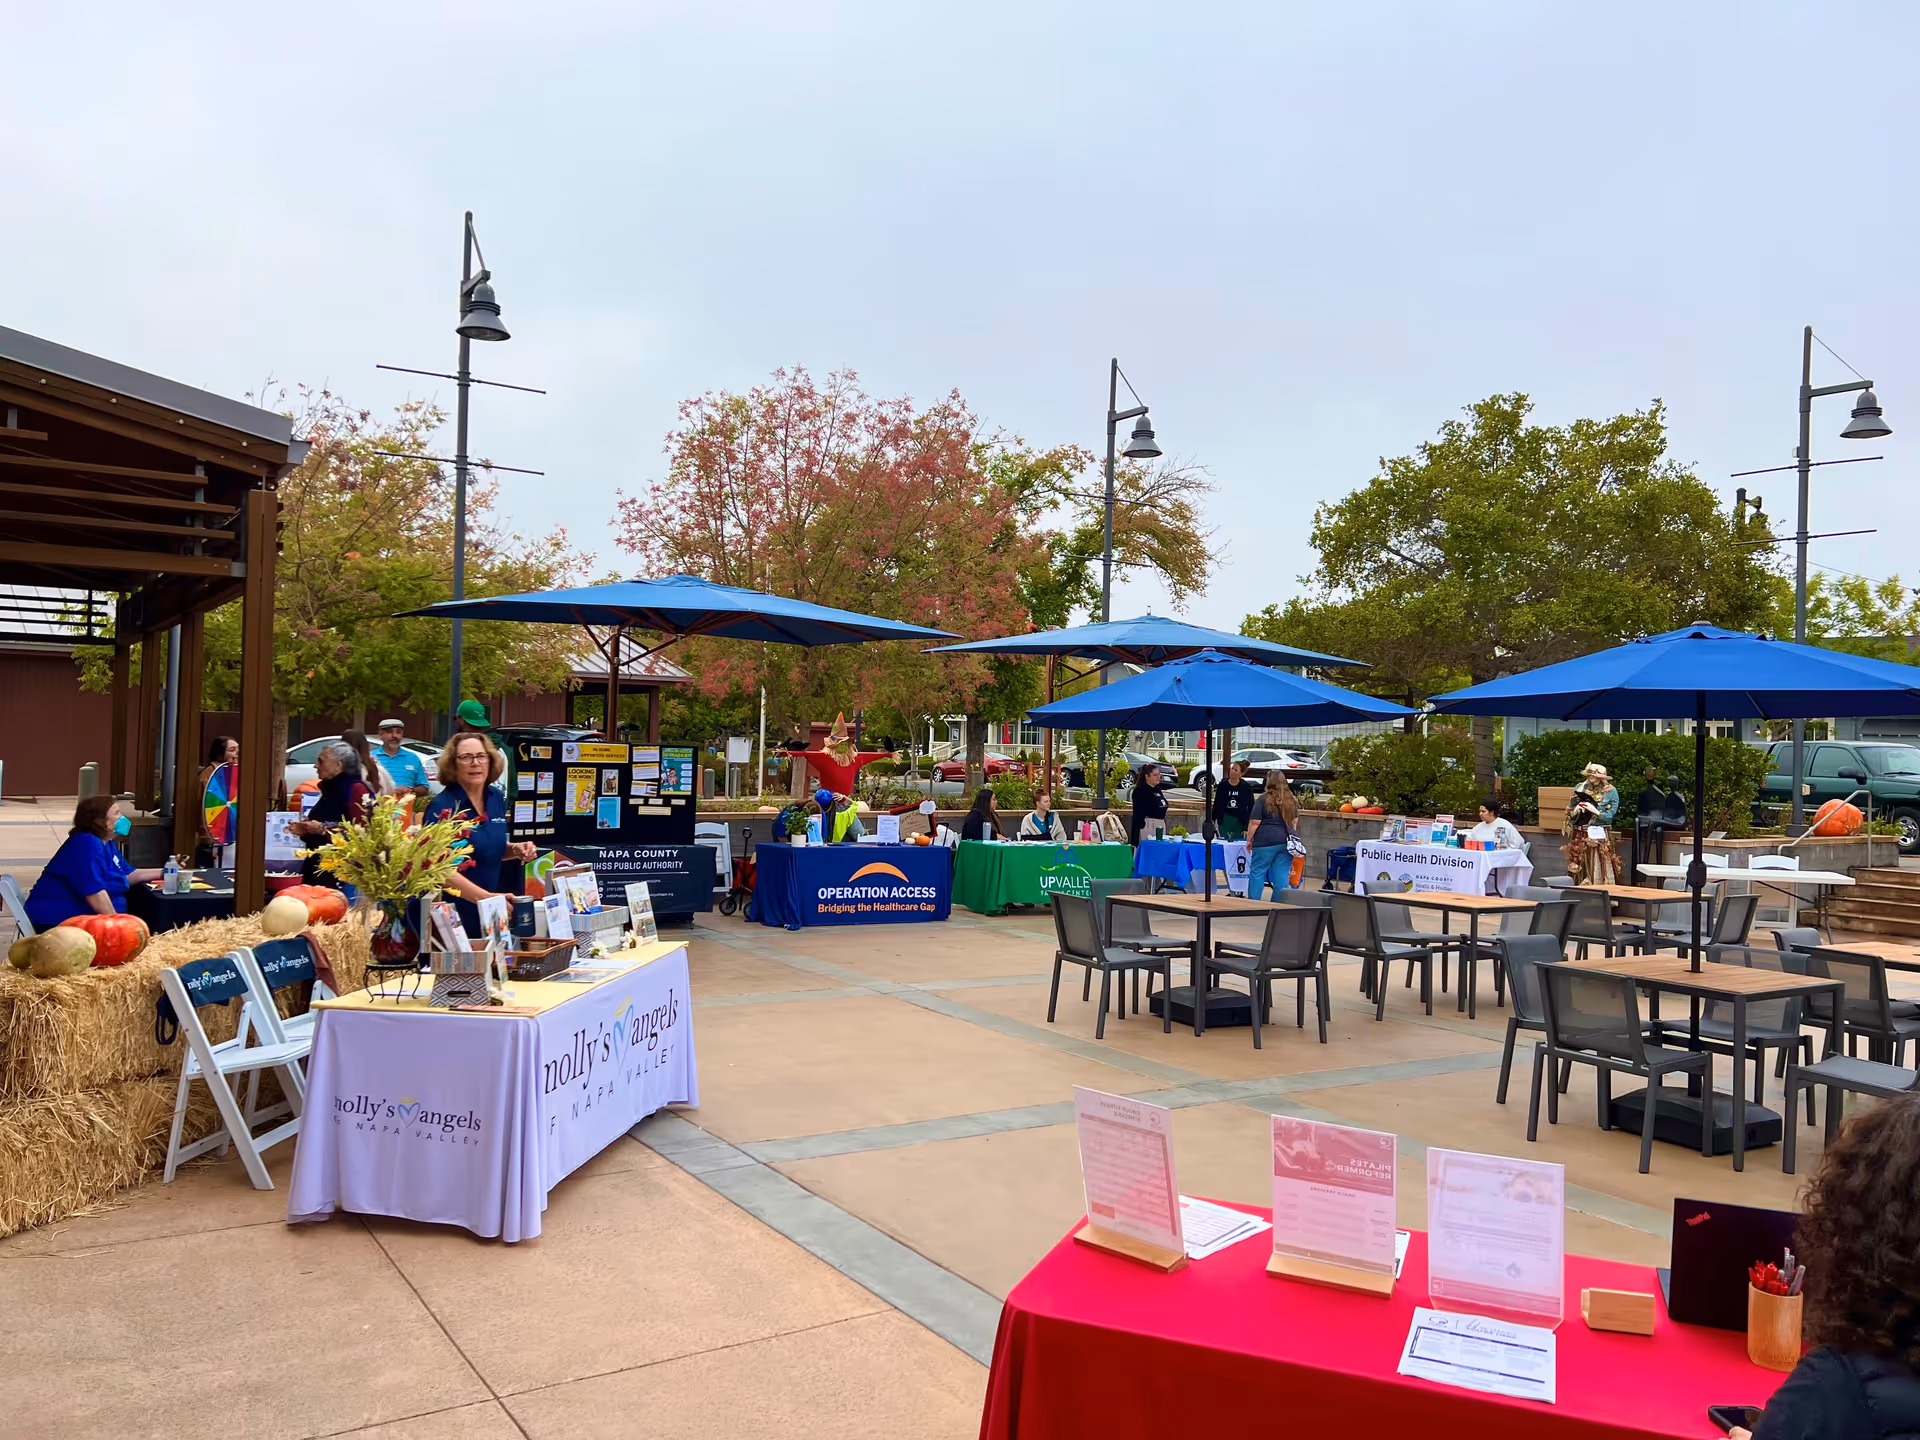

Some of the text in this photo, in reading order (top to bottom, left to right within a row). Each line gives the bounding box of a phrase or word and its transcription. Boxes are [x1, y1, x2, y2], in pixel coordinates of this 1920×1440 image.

[599, 850, 679, 858] NAPA COUNTY
[1361, 848, 1474, 869] Public Health Division
[614, 861, 641, 870] PUBLIC
[642, 860, 684, 869] AUTHORITY
[1040, 876, 1092, 888] UPVALLE
[818, 887, 936, 899] OPERATION ACCESS
[818, 902, 936, 914] Bridging the Healthcare Gap
[212, 970, 236, 985] angels
[631, 988, 678, 1051] angels
[572, 1080, 614, 1121] NAPA
[419, 1110, 482, 1133] angels
[356, 1122, 401, 1135] NAPA
[415, 1130, 480, 1147] VALLEY
